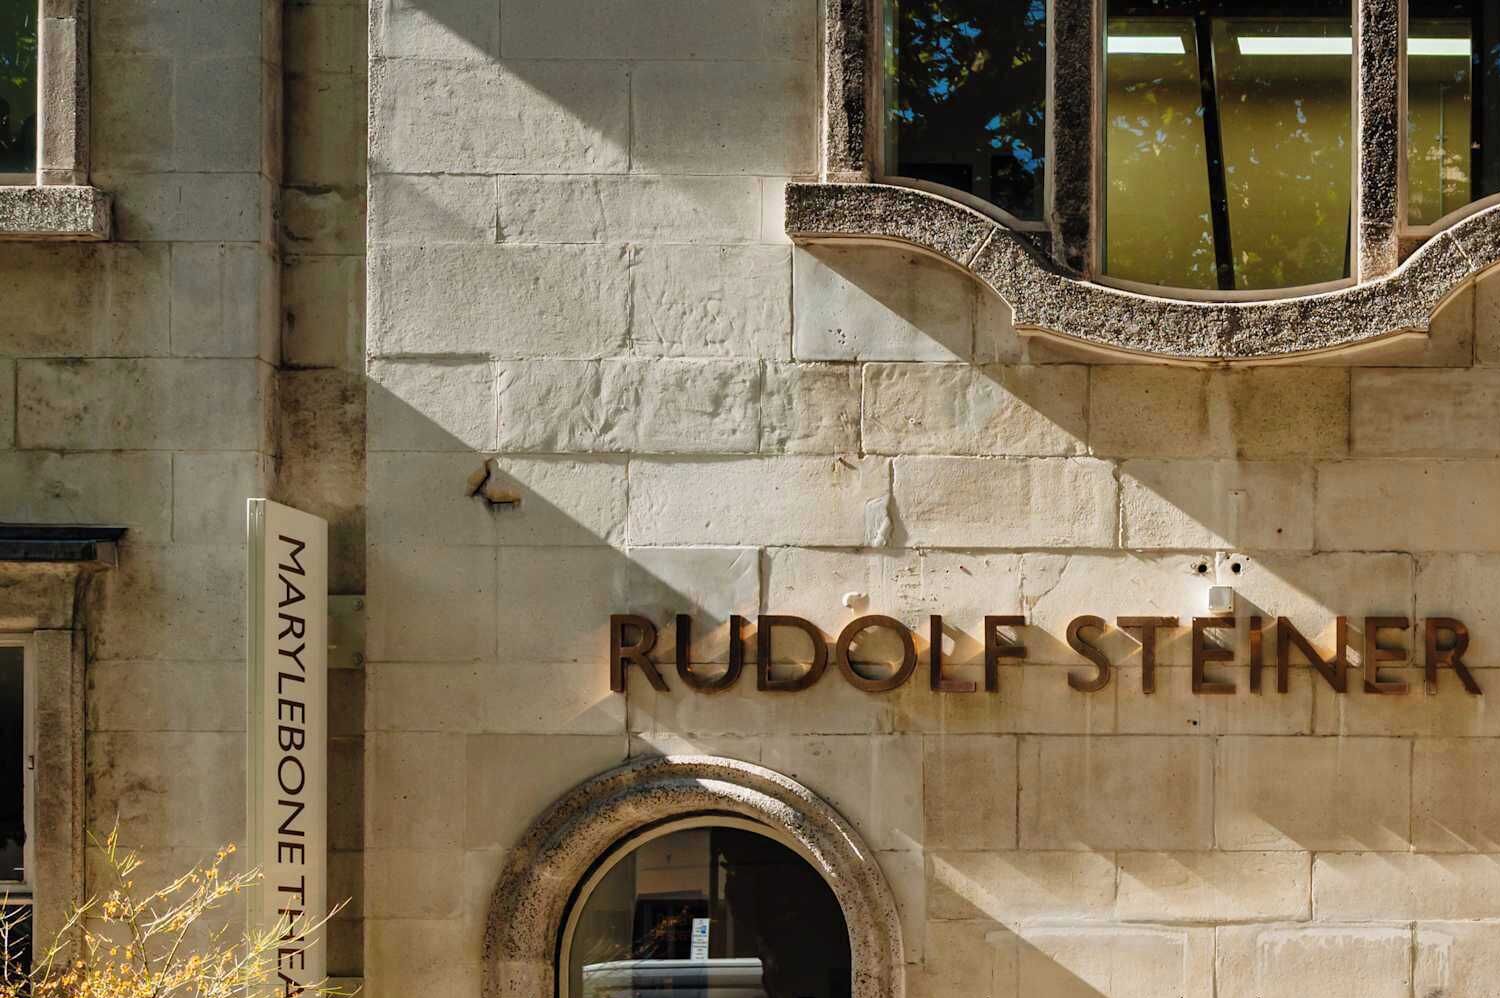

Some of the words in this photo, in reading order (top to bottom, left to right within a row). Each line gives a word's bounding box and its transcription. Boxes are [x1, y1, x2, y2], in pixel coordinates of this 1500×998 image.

[277, 534, 306, 865] MARYLEBONE
[609, 614, 1027, 694] RUDOLF
[1066, 615, 1483, 696] STEINER
